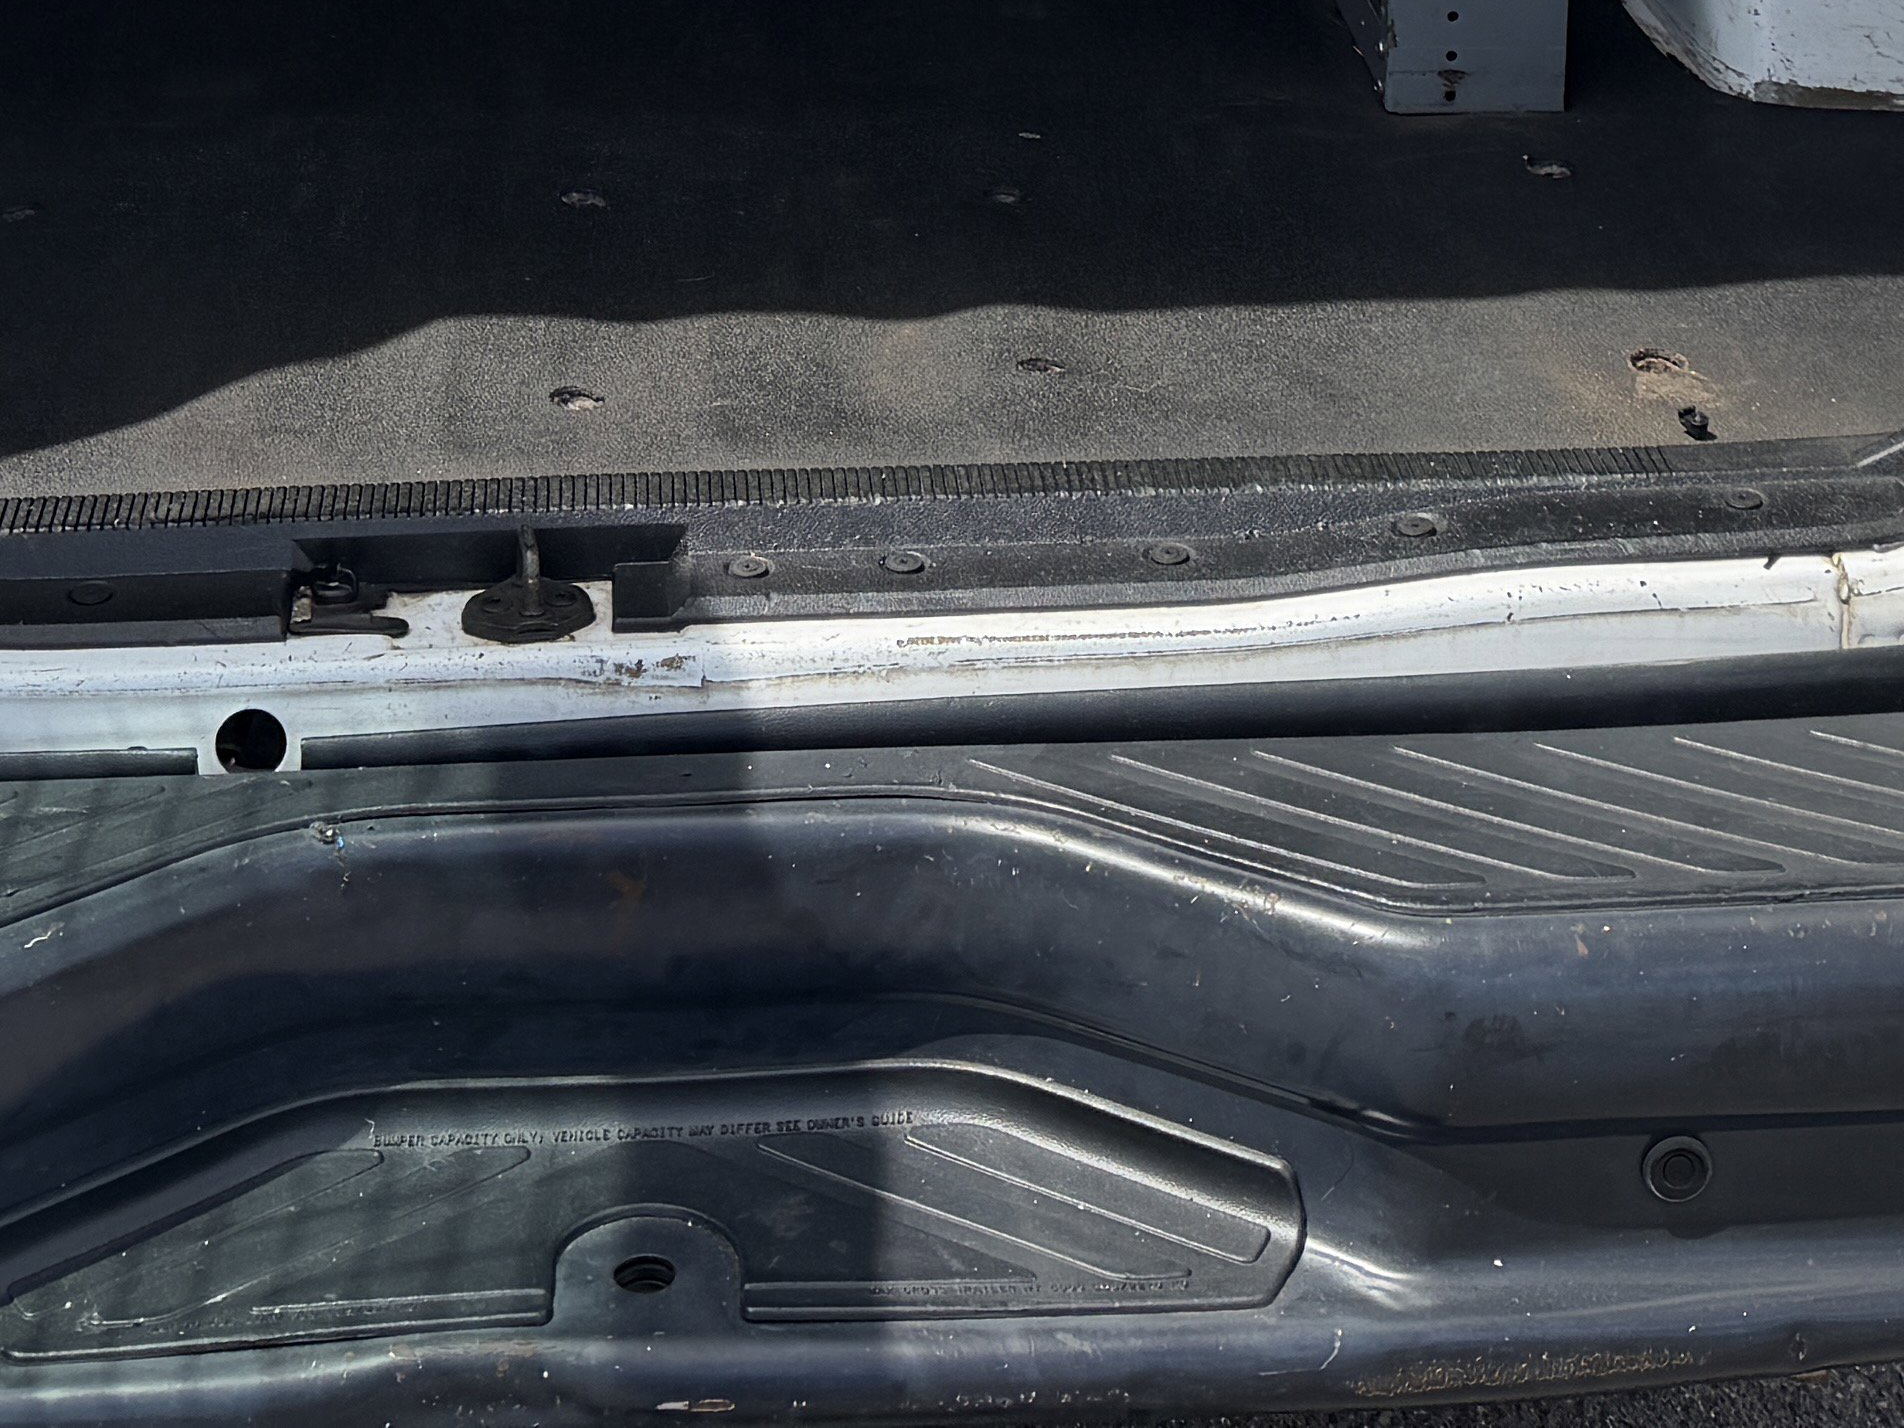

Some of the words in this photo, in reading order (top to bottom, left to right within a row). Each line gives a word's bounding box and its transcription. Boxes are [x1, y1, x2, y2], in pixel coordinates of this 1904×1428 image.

[374, 1132, 426, 1147] BUMPER
[430, 1131, 497, 1145] CAPACITY
[551, 1127, 610, 1142] VEHICLE
[720, 1122, 772, 1137] DIFFER
[776, 1120, 802, 1133] SEE
[872, 1111, 914, 1127] GUIDE
